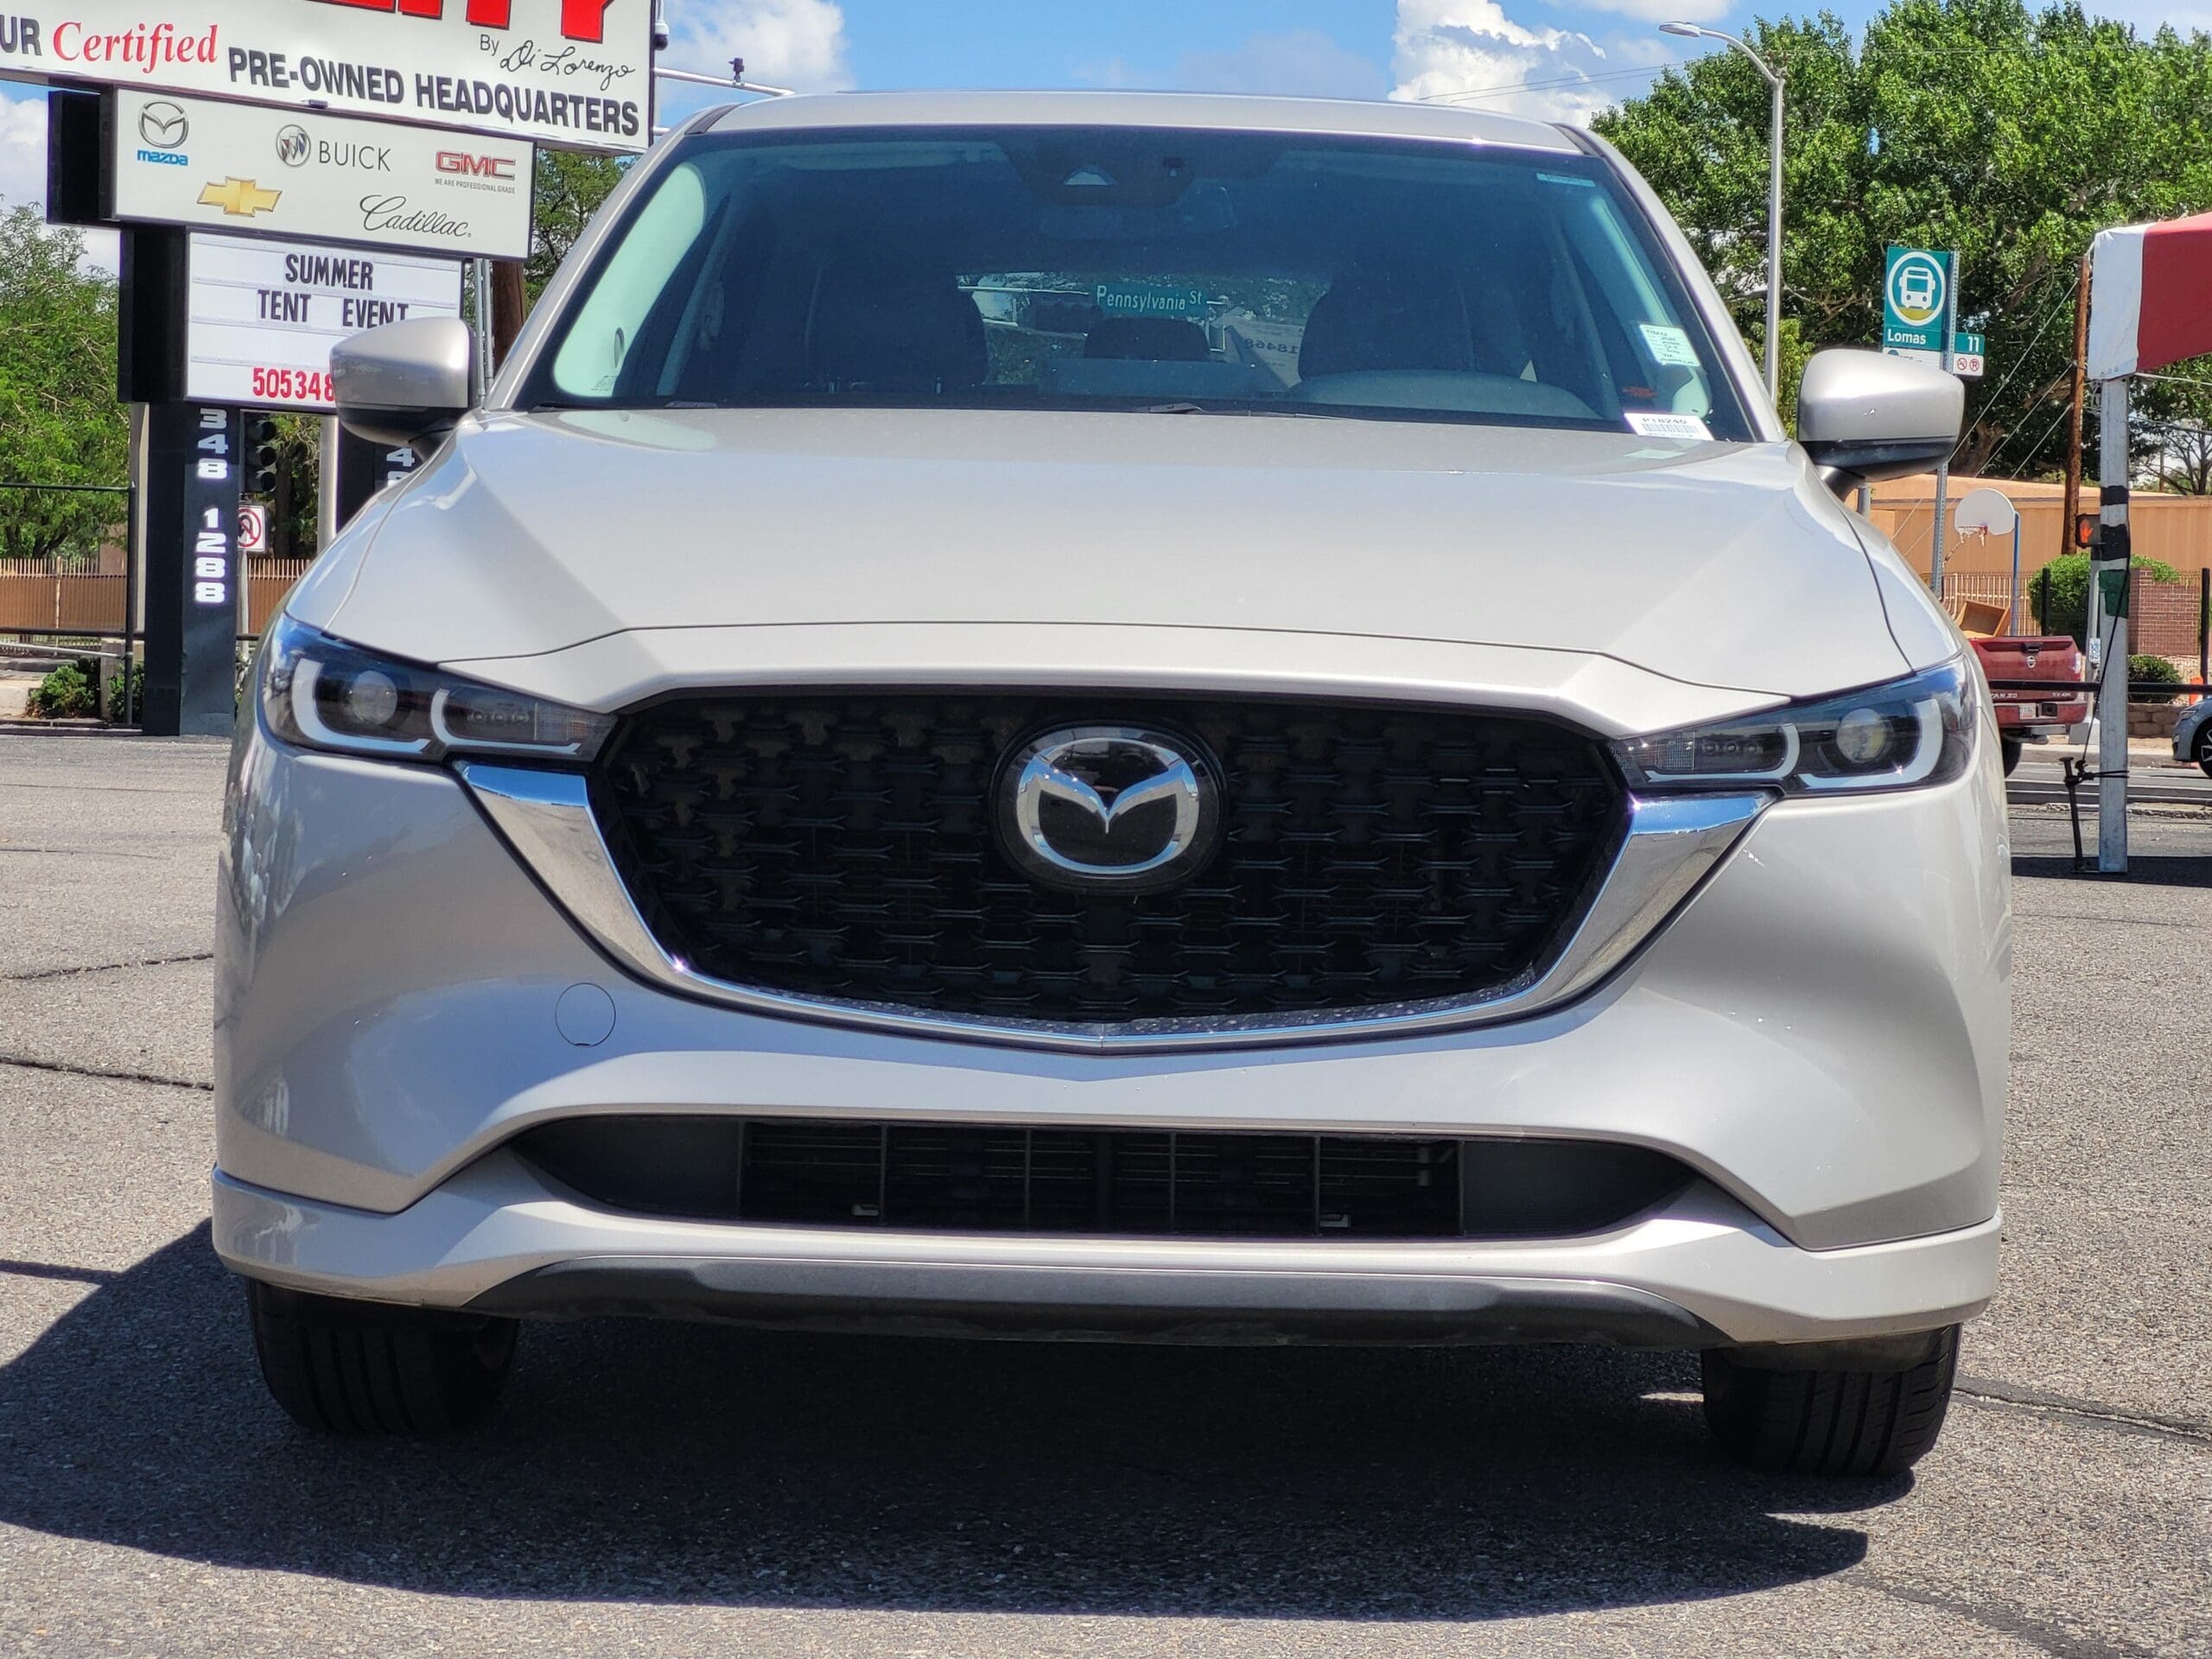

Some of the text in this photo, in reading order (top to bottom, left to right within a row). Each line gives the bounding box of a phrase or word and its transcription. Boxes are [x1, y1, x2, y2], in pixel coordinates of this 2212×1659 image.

[480, 34, 499, 56] By
[541, 46, 635, 90] Lorenzo
[54, 22, 218, 73] Certified
[229, 47, 404, 104] PRE-OWNED
[416, 74, 639, 137] HEADQUARTERS
[137, 149, 188, 166] mazda
[319, 141, 391, 172] BUICK
[435, 149, 516, 181] GMC
[456, 181, 496, 192] PROFESSIONAL
[359, 194, 471, 238] Cadillac
[286, 254, 373, 290] SUMMER
[257, 289, 409, 328] TENT EVENT
[1096, 285, 1202, 312] Pennsylvania St
[1887, 328, 1927, 345] Lomas
[1967, 336, 1980, 353] 11
[253, 368, 334, 401] 505348
